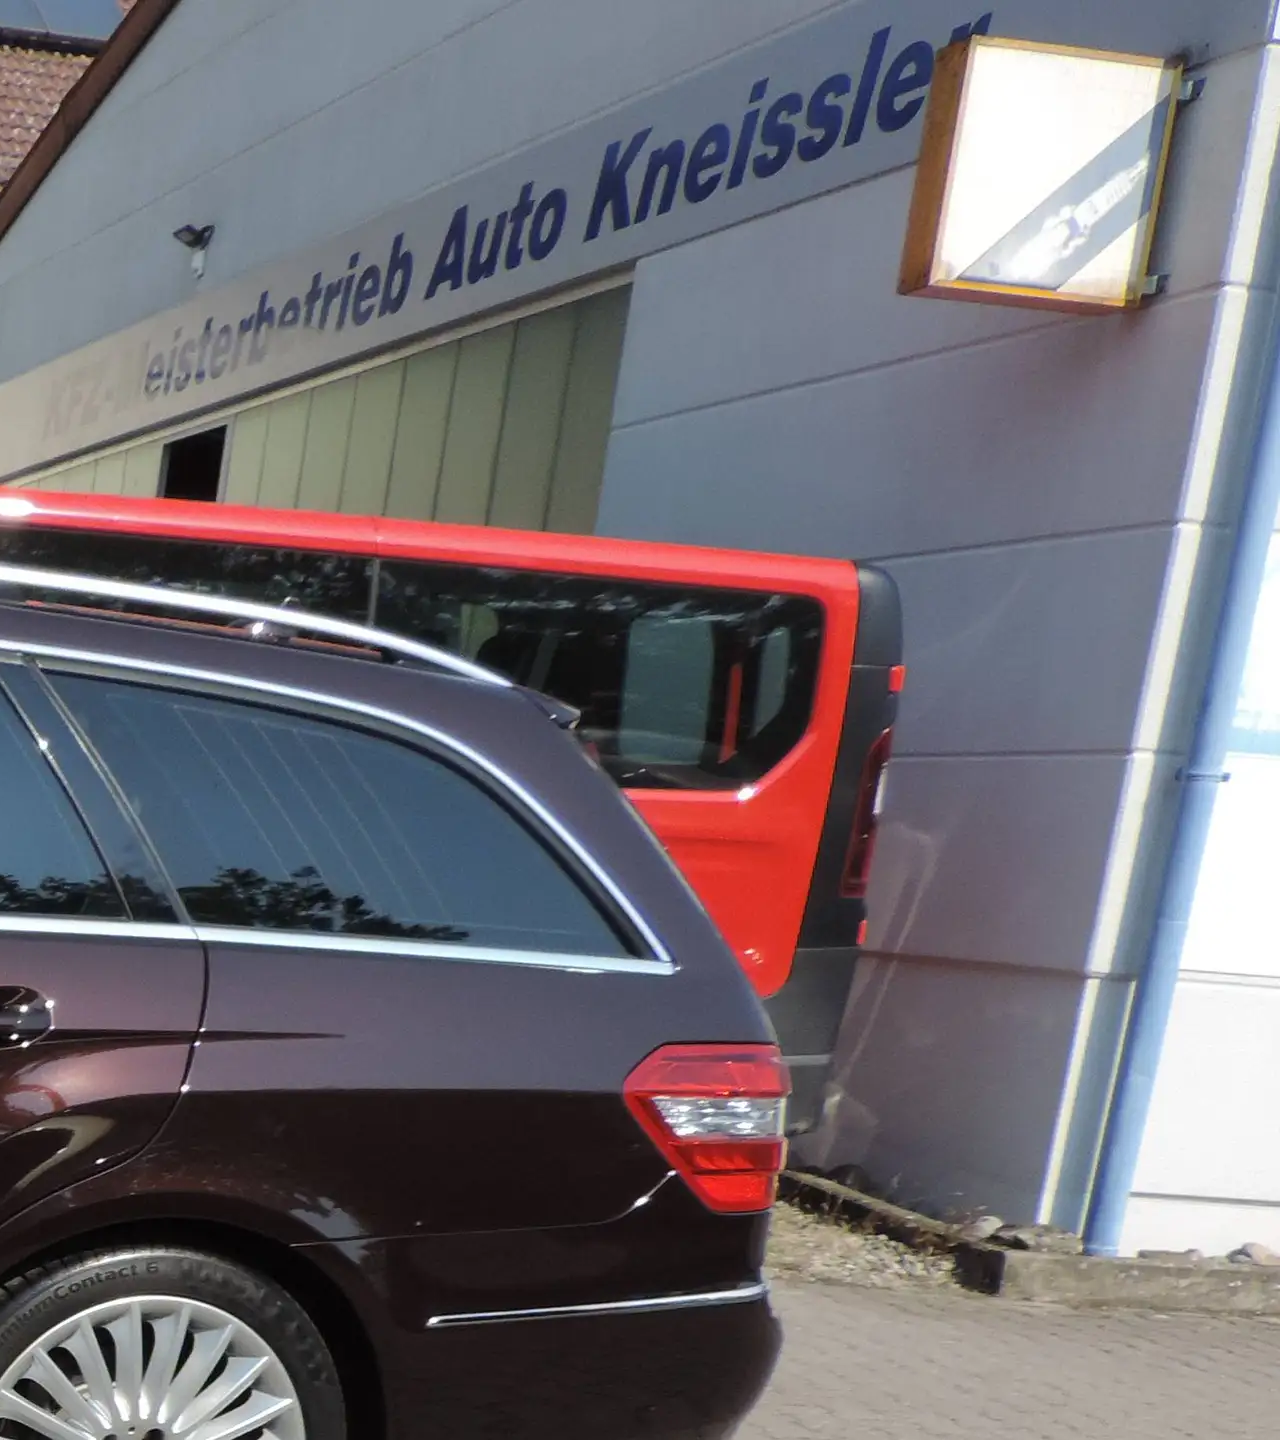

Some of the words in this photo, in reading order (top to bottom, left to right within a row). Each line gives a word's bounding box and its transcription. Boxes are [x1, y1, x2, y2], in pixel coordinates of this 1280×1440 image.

[424, 181, 566, 299] Auto
[583, 12, 992, 242] Kneissle
[146, 1261, 160, 1275] 6
